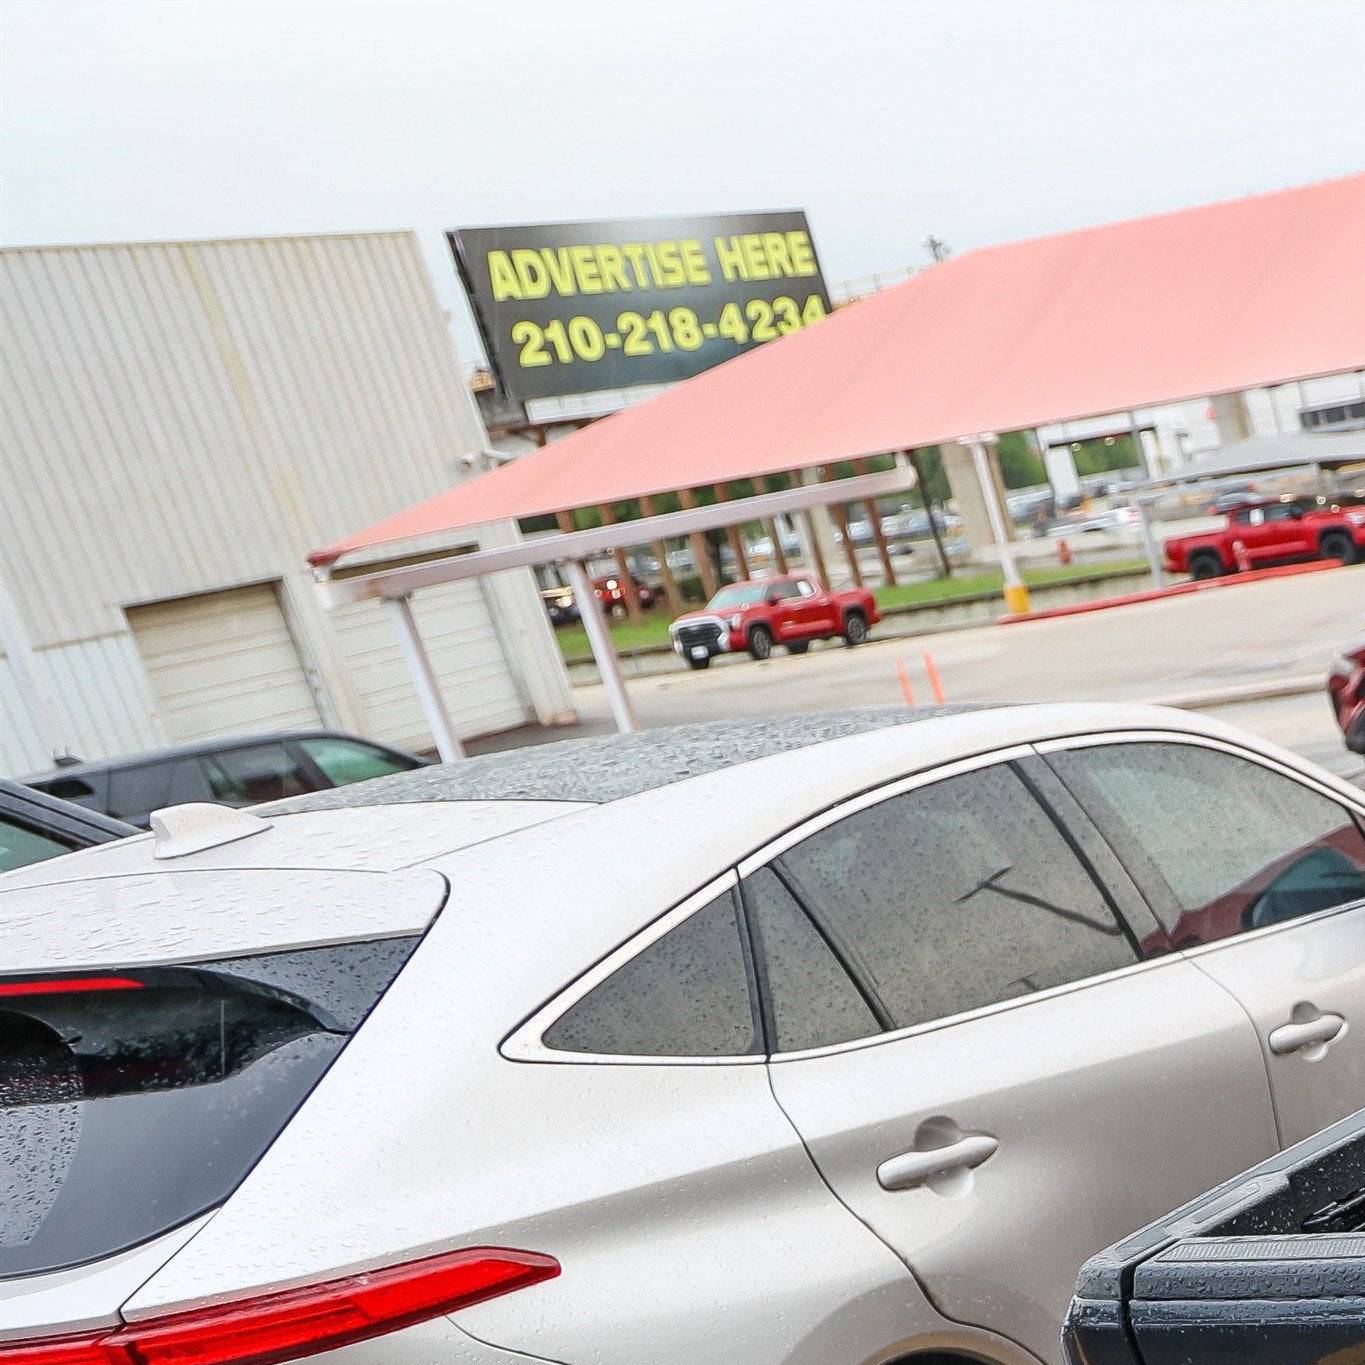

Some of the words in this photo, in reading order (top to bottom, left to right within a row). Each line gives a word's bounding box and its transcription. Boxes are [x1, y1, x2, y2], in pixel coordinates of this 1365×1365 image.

[487, 239, 712, 302] ADVERTISE
[714, 230, 818, 283] HERE
[511, 293, 827, 368] 210-218-4234
